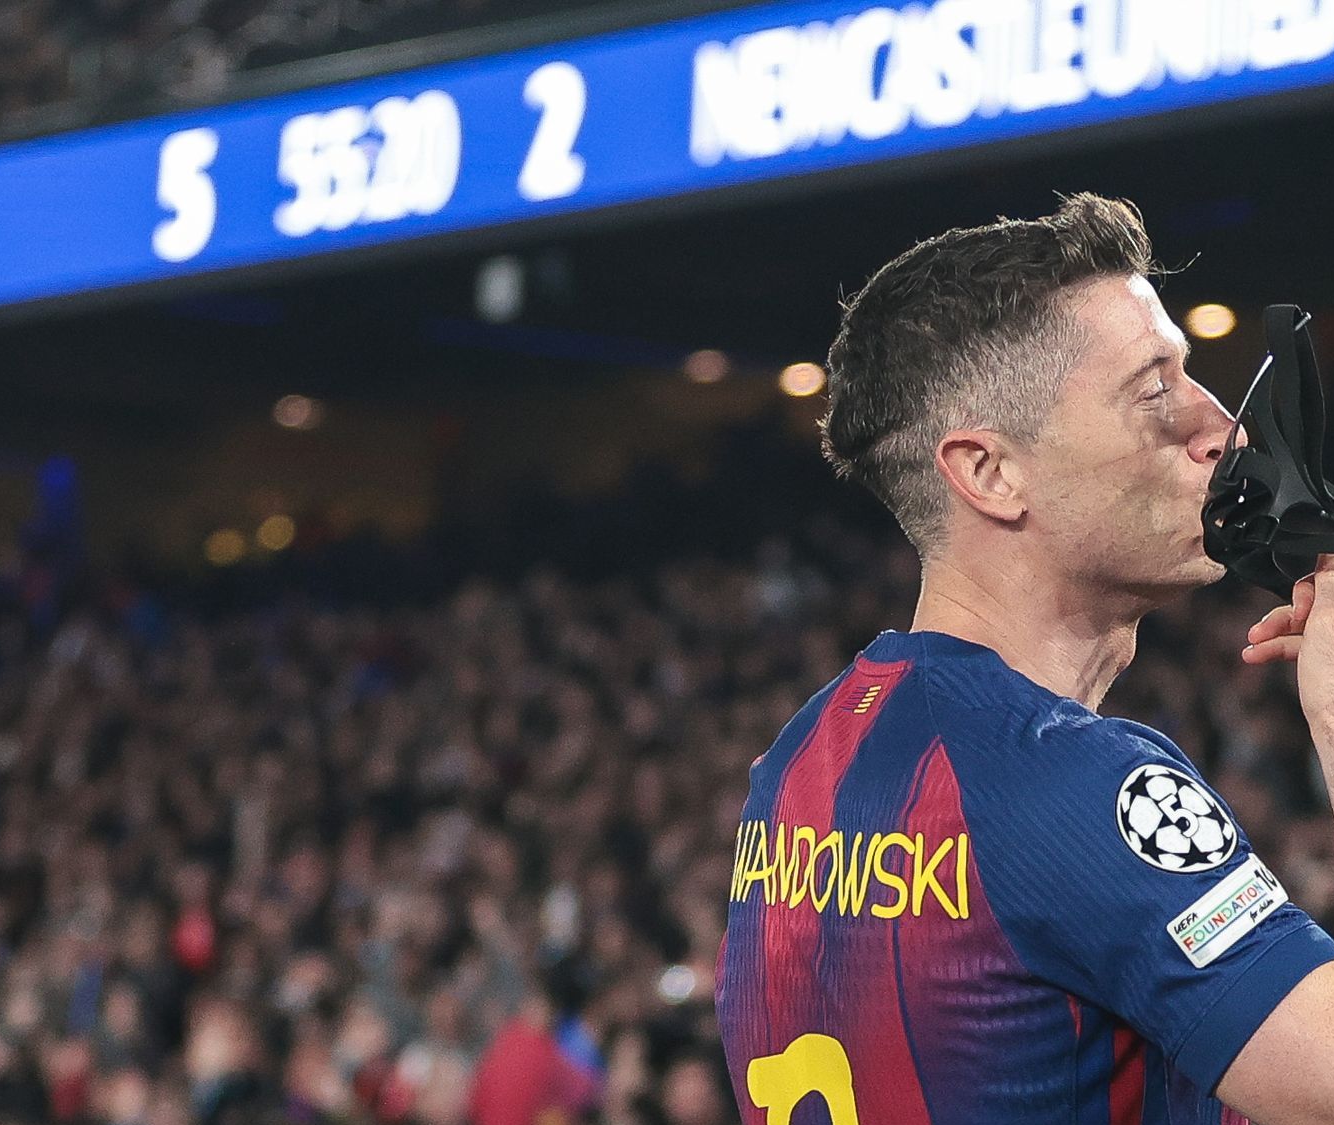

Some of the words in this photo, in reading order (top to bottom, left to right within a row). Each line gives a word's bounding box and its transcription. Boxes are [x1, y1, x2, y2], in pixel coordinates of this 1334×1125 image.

[153, 127, 219, 262] 5
[520, 60, 588, 201] 2
[1158, 793, 1199, 839] 5
[1183, 881, 1264, 951] FOUNDATION
